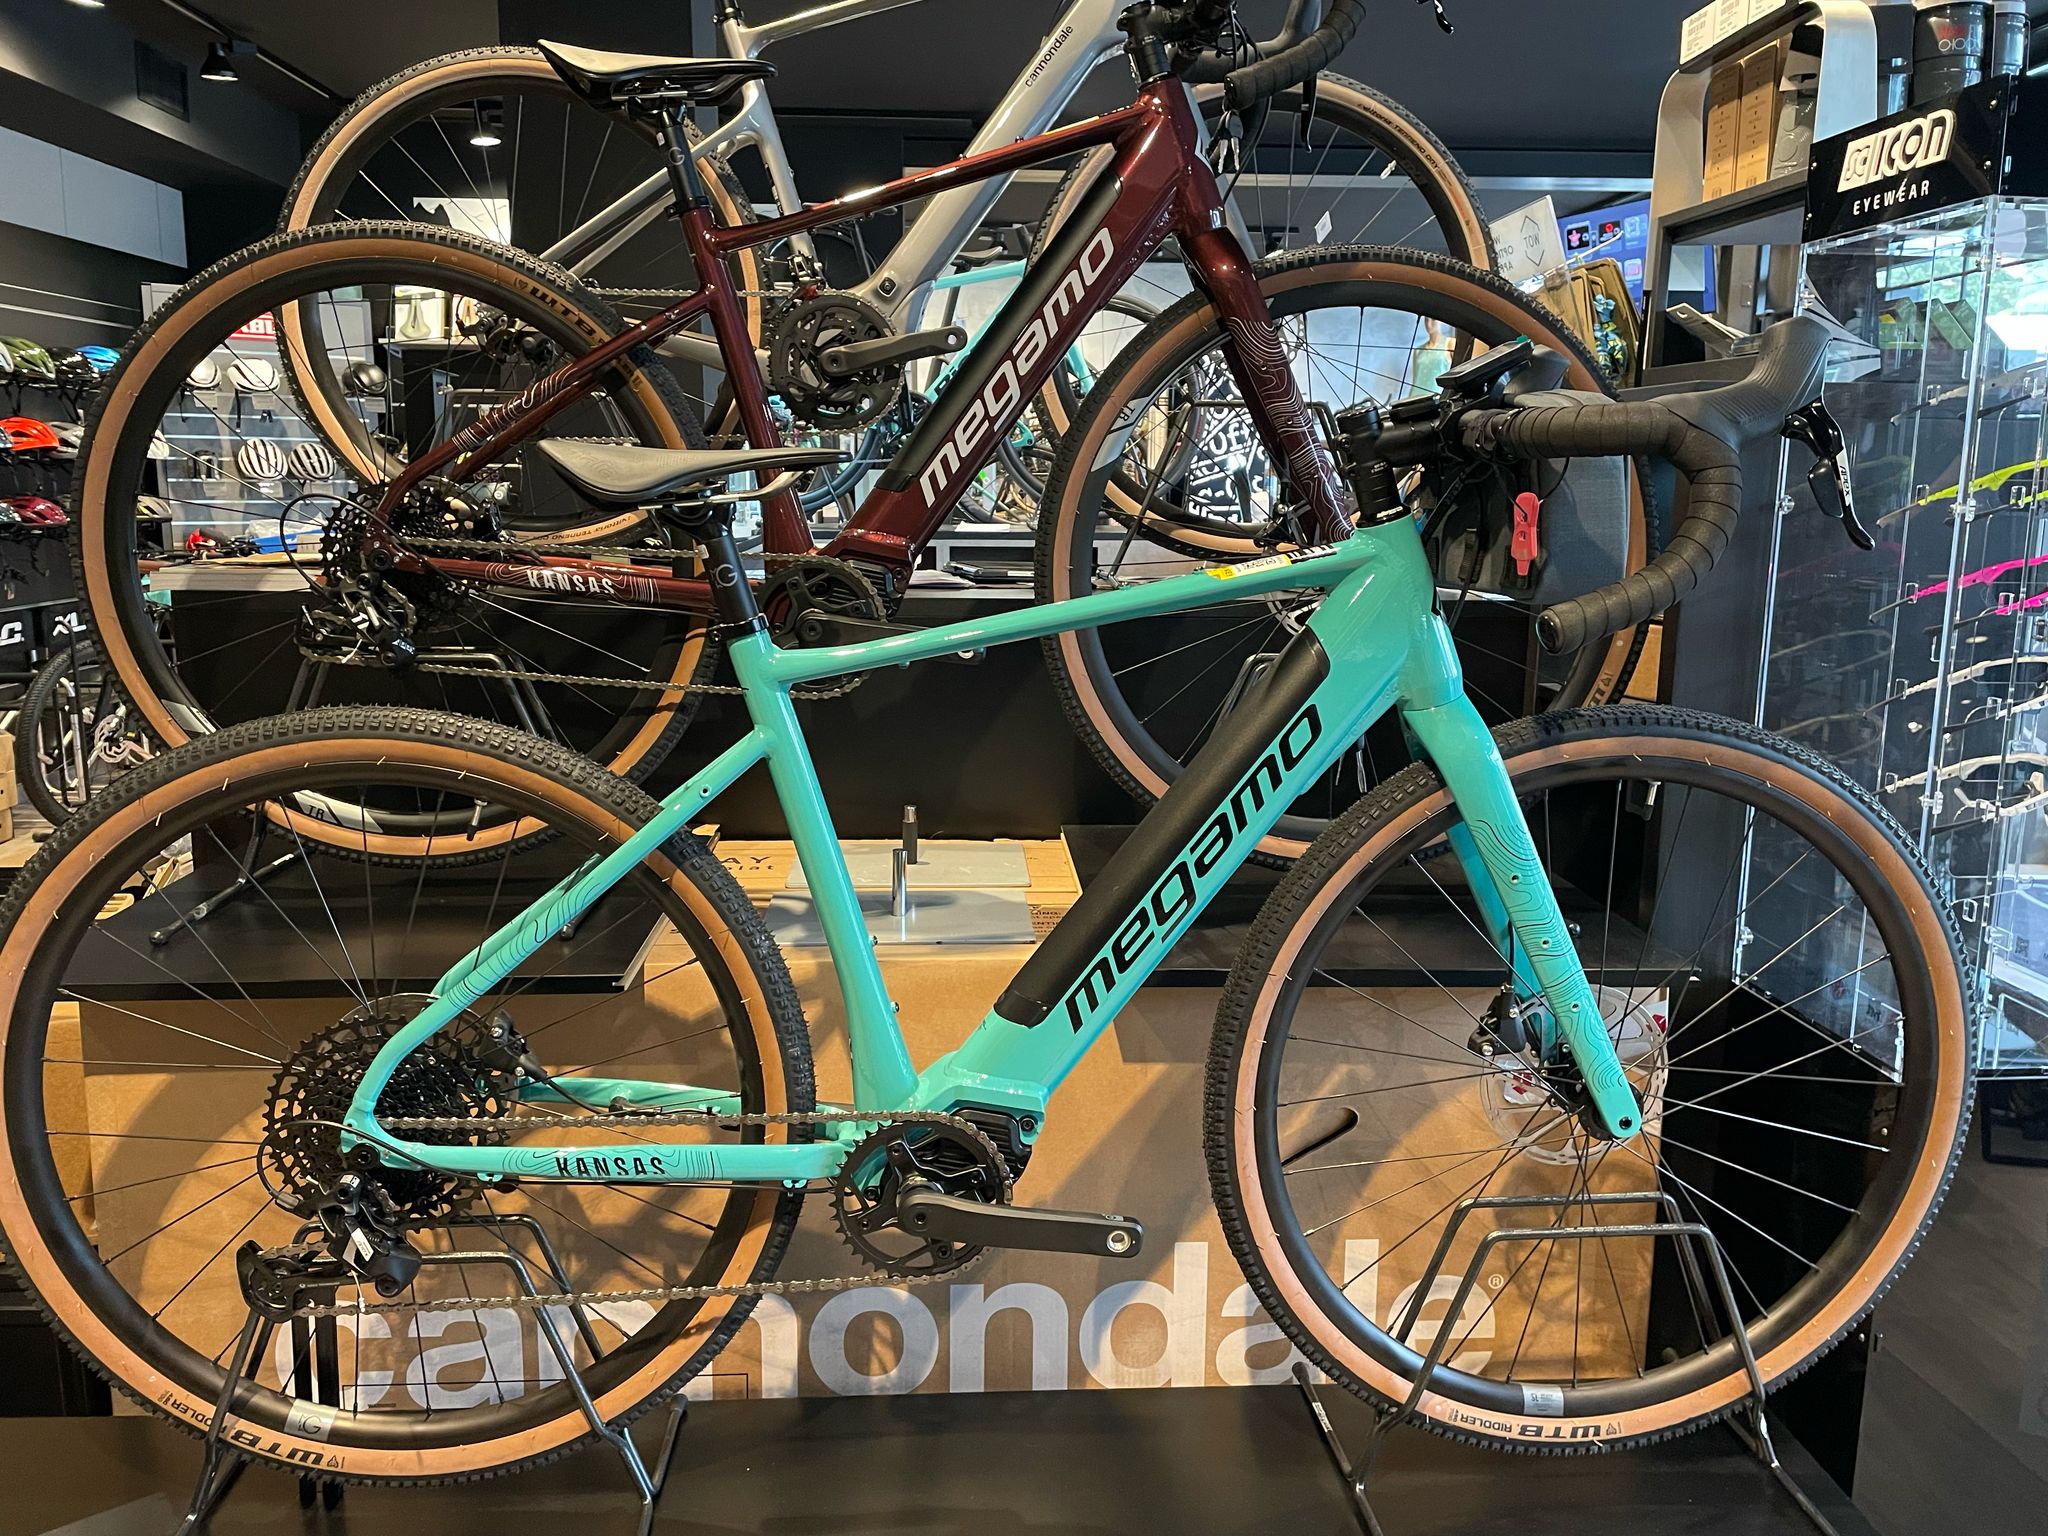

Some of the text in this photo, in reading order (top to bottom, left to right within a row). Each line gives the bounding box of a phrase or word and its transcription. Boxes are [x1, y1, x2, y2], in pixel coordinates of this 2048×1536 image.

[1025, 26, 1073, 87] cannondale
[1853, 180, 1930, 215] EYEWEAR
[529, 286, 597, 337] WTB
[919, 227, 1115, 509] megamo
[526, 569, 615, 594] KANSAS
[307, 804, 326, 821] TR
[1064, 703, 1323, 1035] megamo
[554, 1156, 666, 1177] KANSAS
[1460, 1413, 1513, 1433] RIDDLER
[1518, 1424, 1601, 1439] WTB
[230, 1429, 325, 1467] WTB
